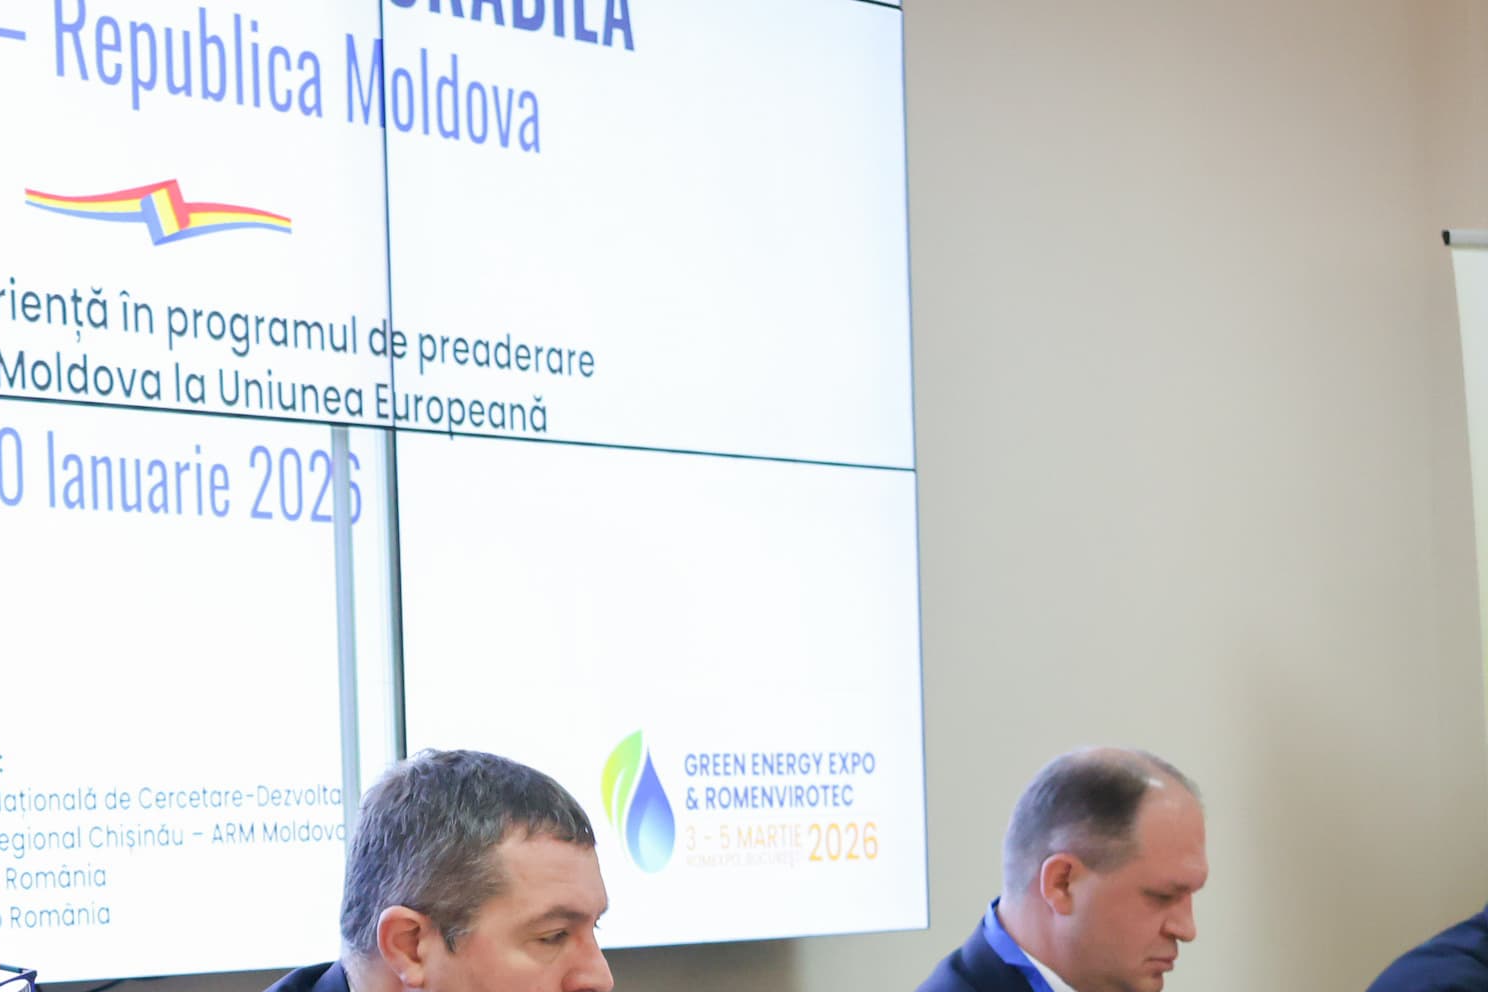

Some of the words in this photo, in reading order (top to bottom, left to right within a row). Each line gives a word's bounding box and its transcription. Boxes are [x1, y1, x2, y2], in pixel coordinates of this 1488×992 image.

[54, 0, 323, 119] Republica
[346, 33, 540, 154] Moldova
[119, 289, 154, 335] în
[168, 316, 357, 356] programul
[369, 320, 408, 359] de
[419, 334, 595, 377] preaderare
[175, 363, 206, 404] la
[218, 368, 363, 417] Uniunea
[375, 383, 547, 439] Europeană
[46, 430, 230, 518] Ianuarie
[684, 753, 746, 776] GREEN
[752, 752, 823, 776] ENERGY
[829, 751, 876, 775] EXPO
[104, 786, 131, 810] de
[138, 784, 342, 809] Cercetare-Dezvolta
[686, 786, 699, 810] &
[705, 784, 854, 809] ROMENVIROTEC
[212, 822, 256, 843] ARM
[808, 821, 879, 861] 2026
[6, 862, 106, 890] România
[10, 901, 110, 928] România
